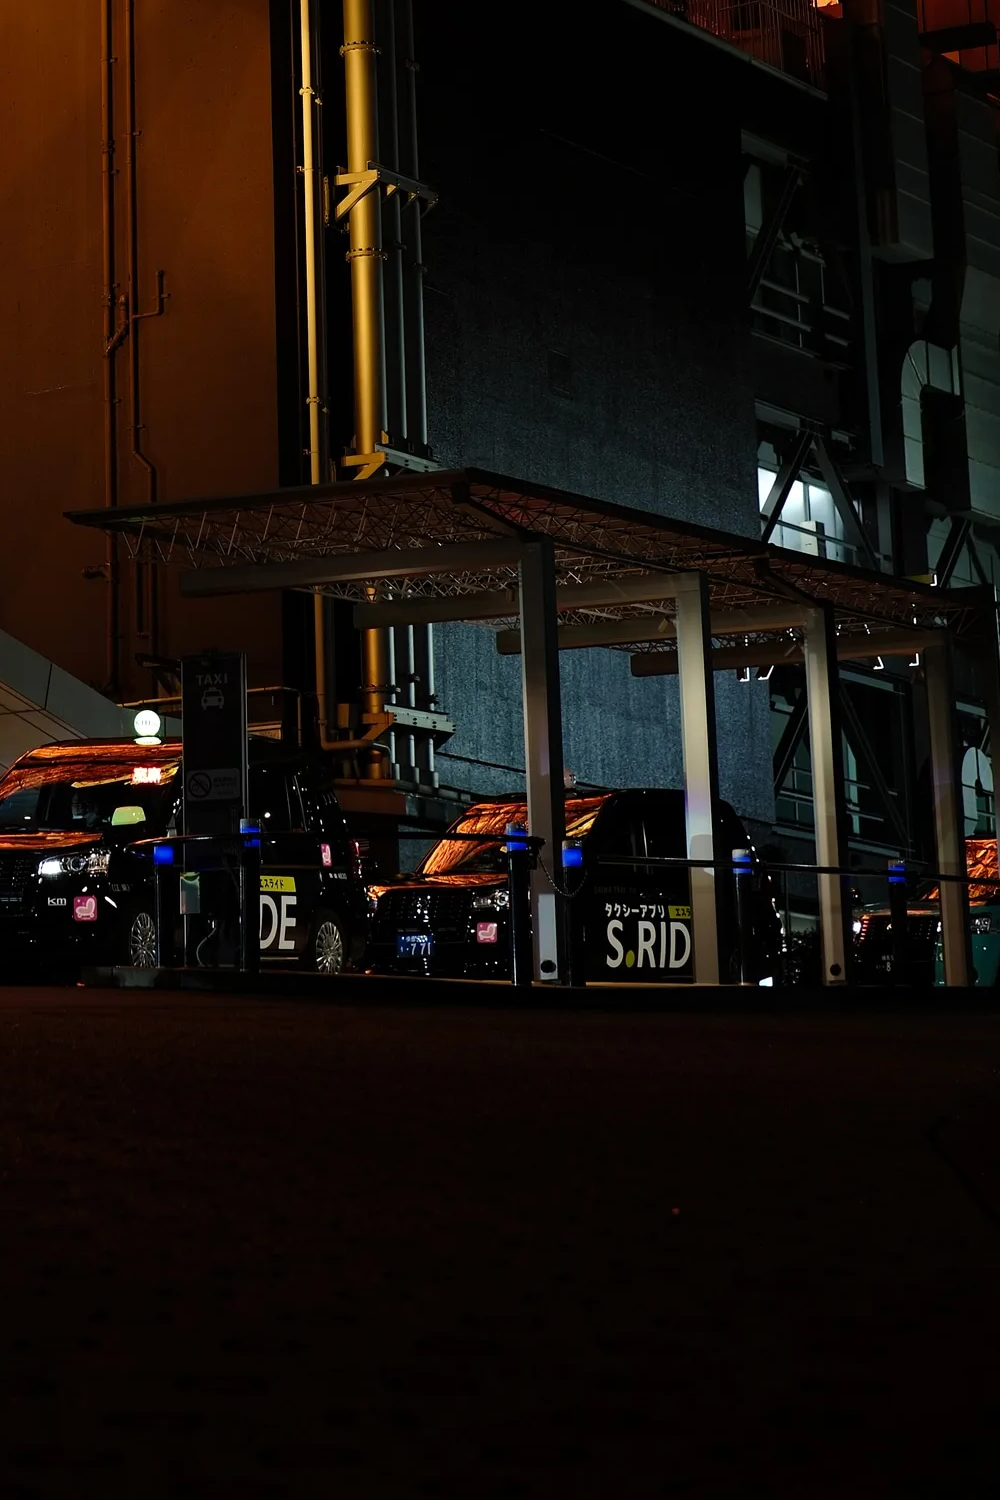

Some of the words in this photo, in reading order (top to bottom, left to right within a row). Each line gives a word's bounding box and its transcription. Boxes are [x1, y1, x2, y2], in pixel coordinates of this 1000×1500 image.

[196, 672, 228, 686] TAXI
[605, 903, 665, 918] タクシーアプリ
[259, 894, 297, 950] DE
